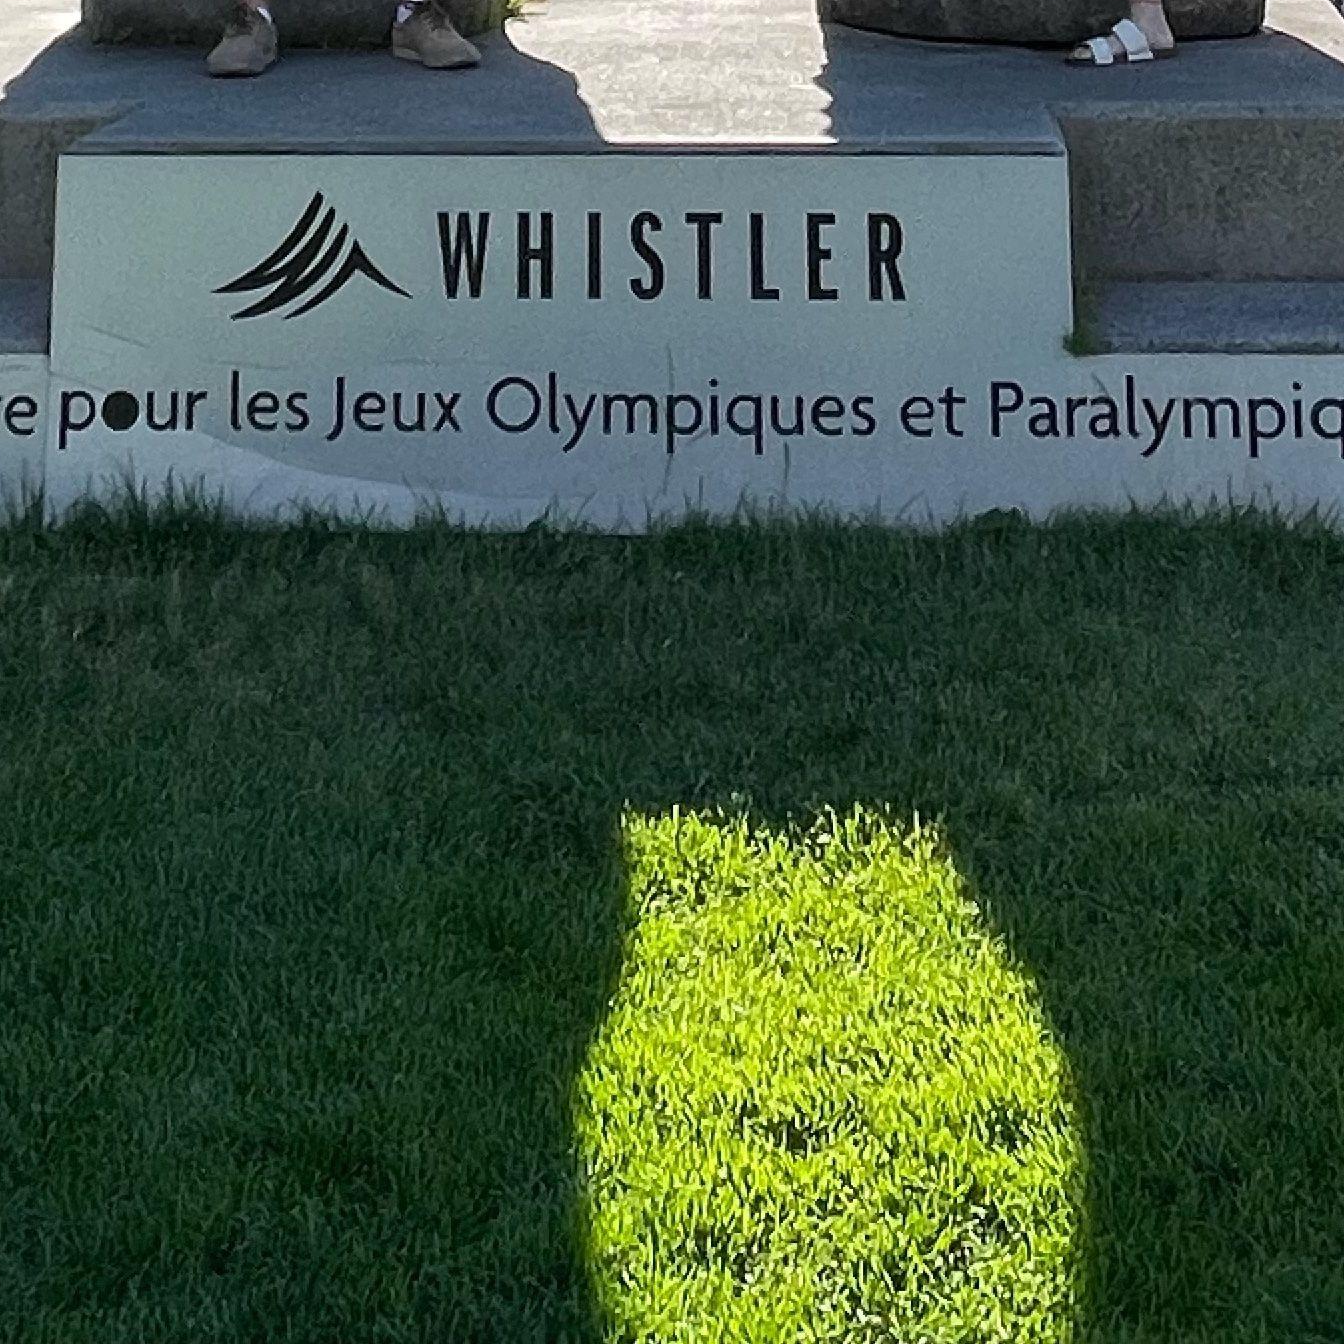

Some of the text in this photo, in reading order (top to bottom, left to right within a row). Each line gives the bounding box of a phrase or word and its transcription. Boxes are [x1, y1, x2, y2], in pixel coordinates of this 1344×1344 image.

[436, 212, 906, 301] WHISTLER
[58, 390, 208, 450] pour
[230, 370, 310, 432] les
[326, 376, 461, 442] Jeux
[486, 372, 876, 456] Olympiques
[900, 386, 966, 438] et
